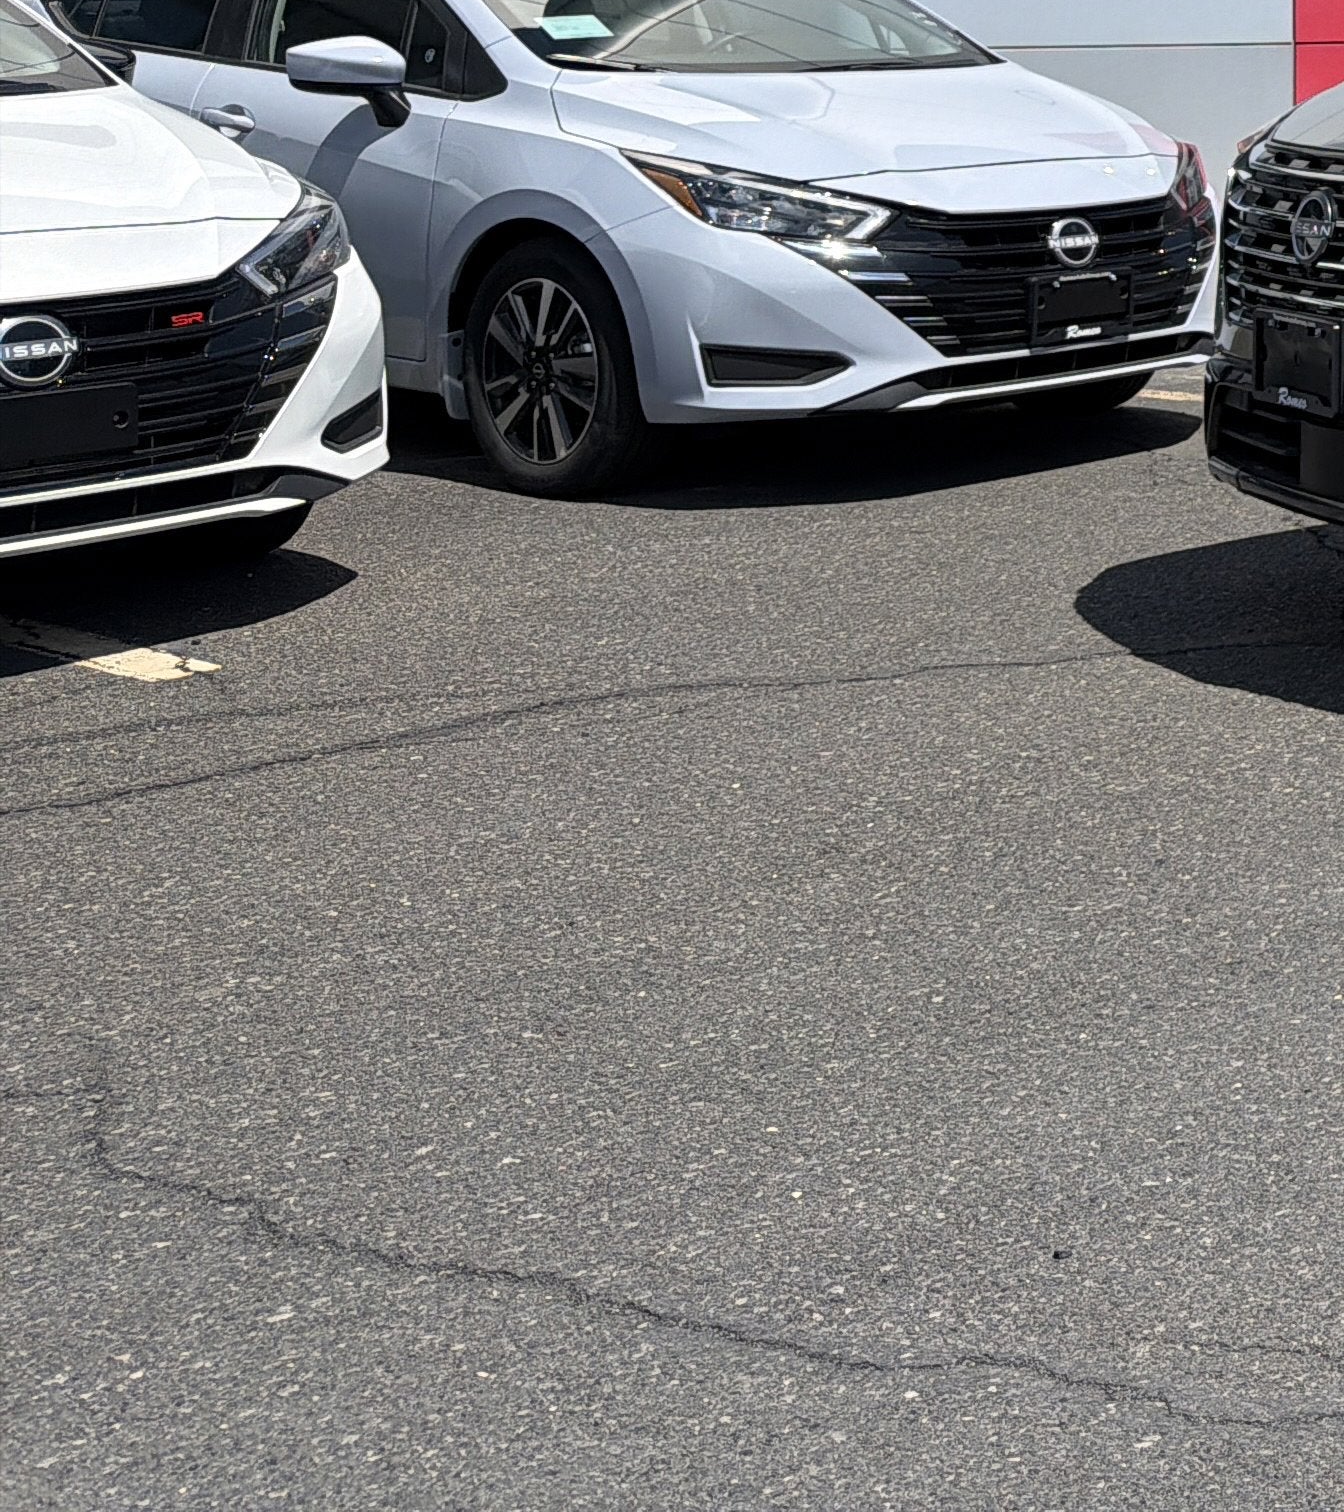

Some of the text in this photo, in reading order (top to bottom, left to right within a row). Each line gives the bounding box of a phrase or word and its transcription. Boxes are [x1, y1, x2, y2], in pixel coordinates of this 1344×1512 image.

[1048, 234, 1099, 249] NISSAN
[171, 311, 205, 327] SR
[0, 339, 77, 359] ISSAN
